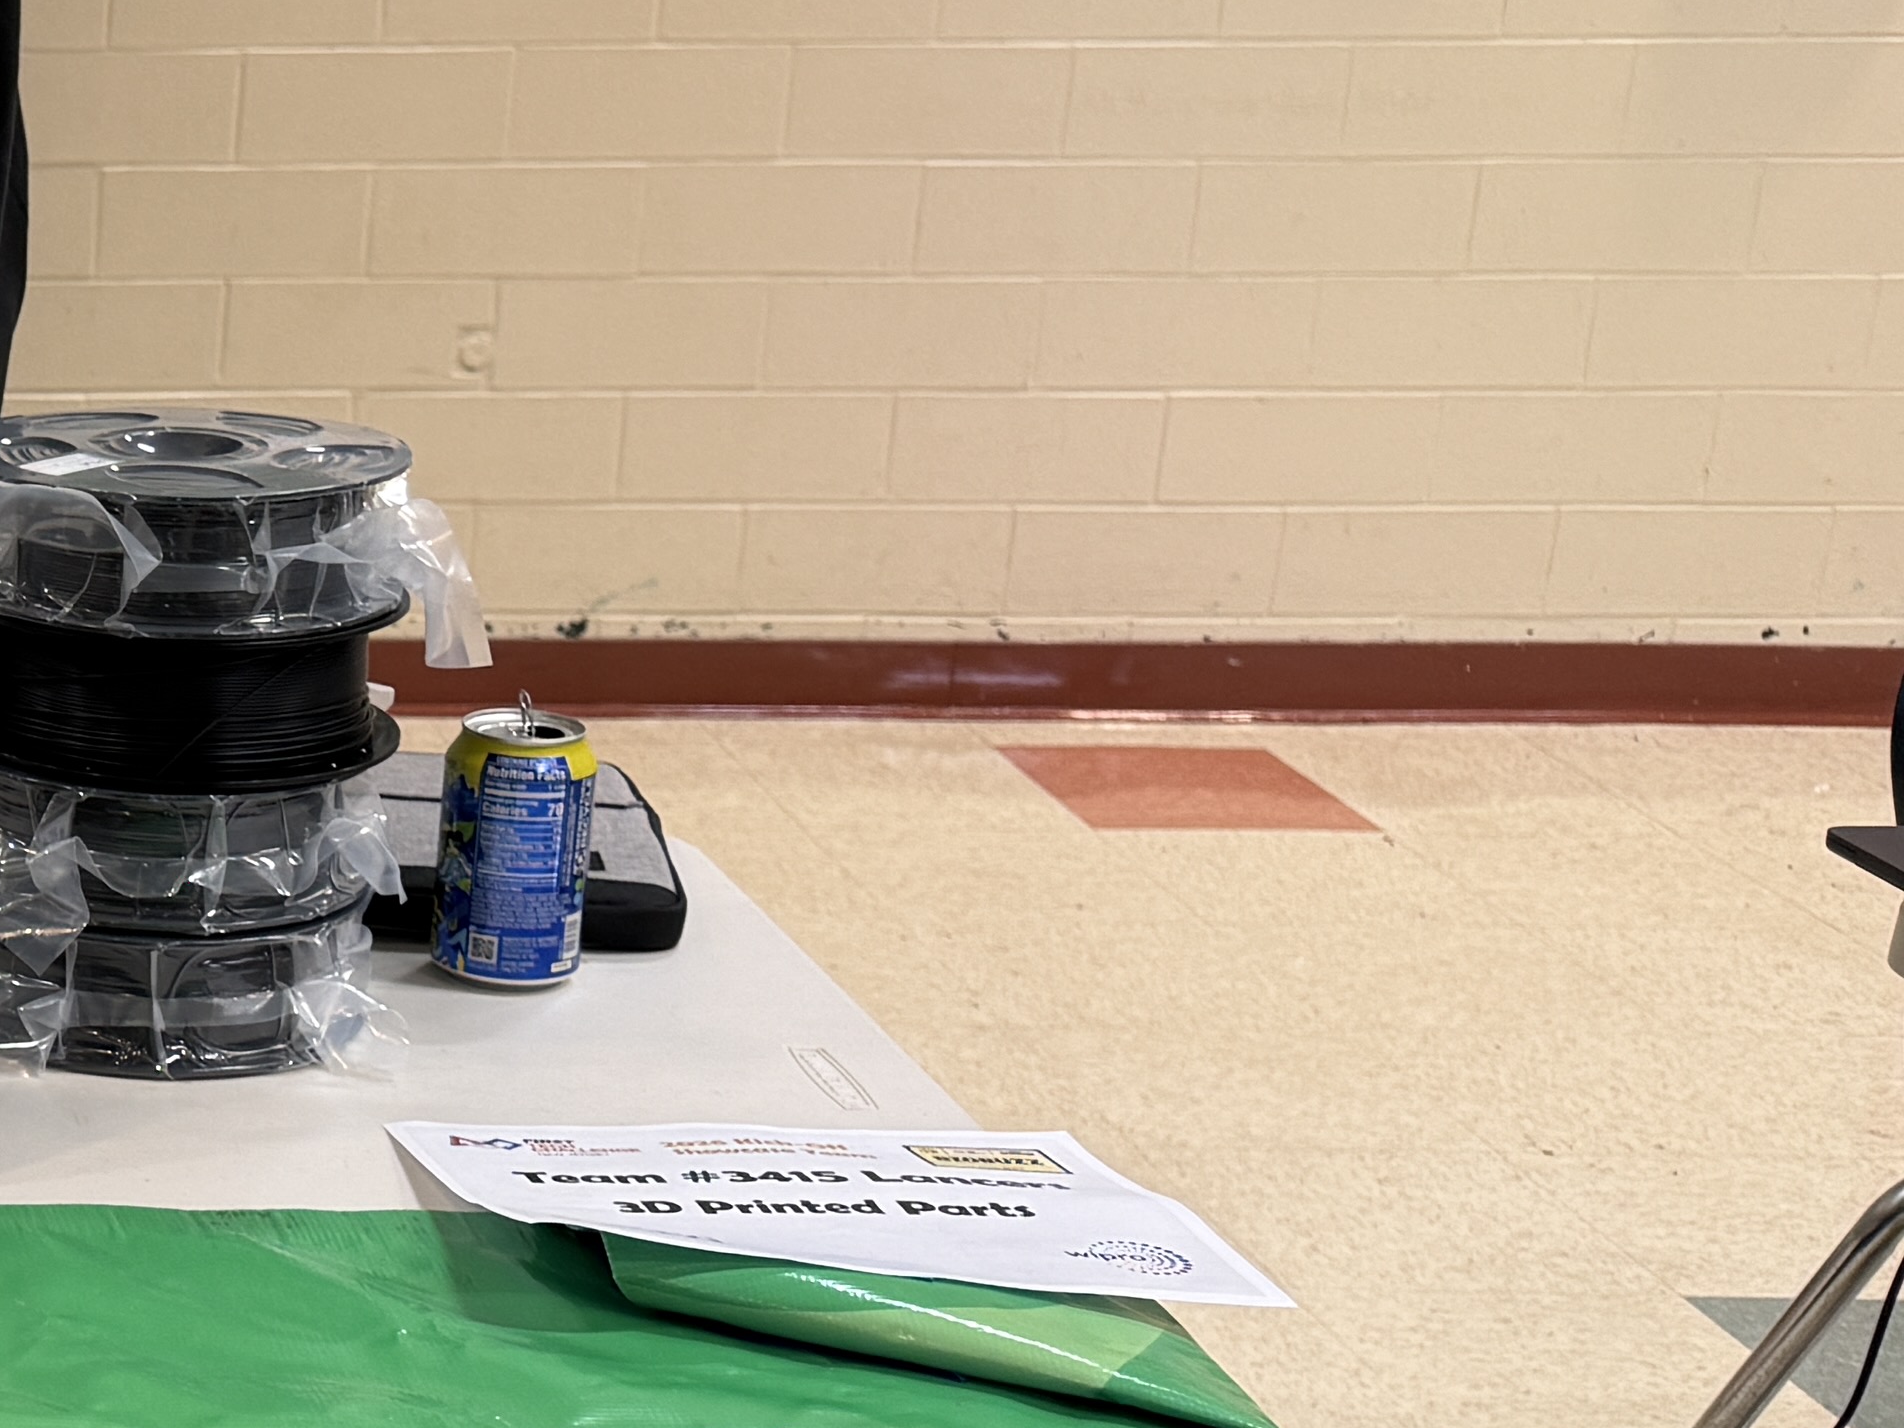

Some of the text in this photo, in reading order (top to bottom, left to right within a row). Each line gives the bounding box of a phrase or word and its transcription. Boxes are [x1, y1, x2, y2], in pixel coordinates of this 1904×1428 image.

[512, 1168, 1073, 1191] Team #3415 Lancers
[613, 1199, 1037, 1219] 3D Printed Parts
[1065, 1246, 1149, 1265] wipro
